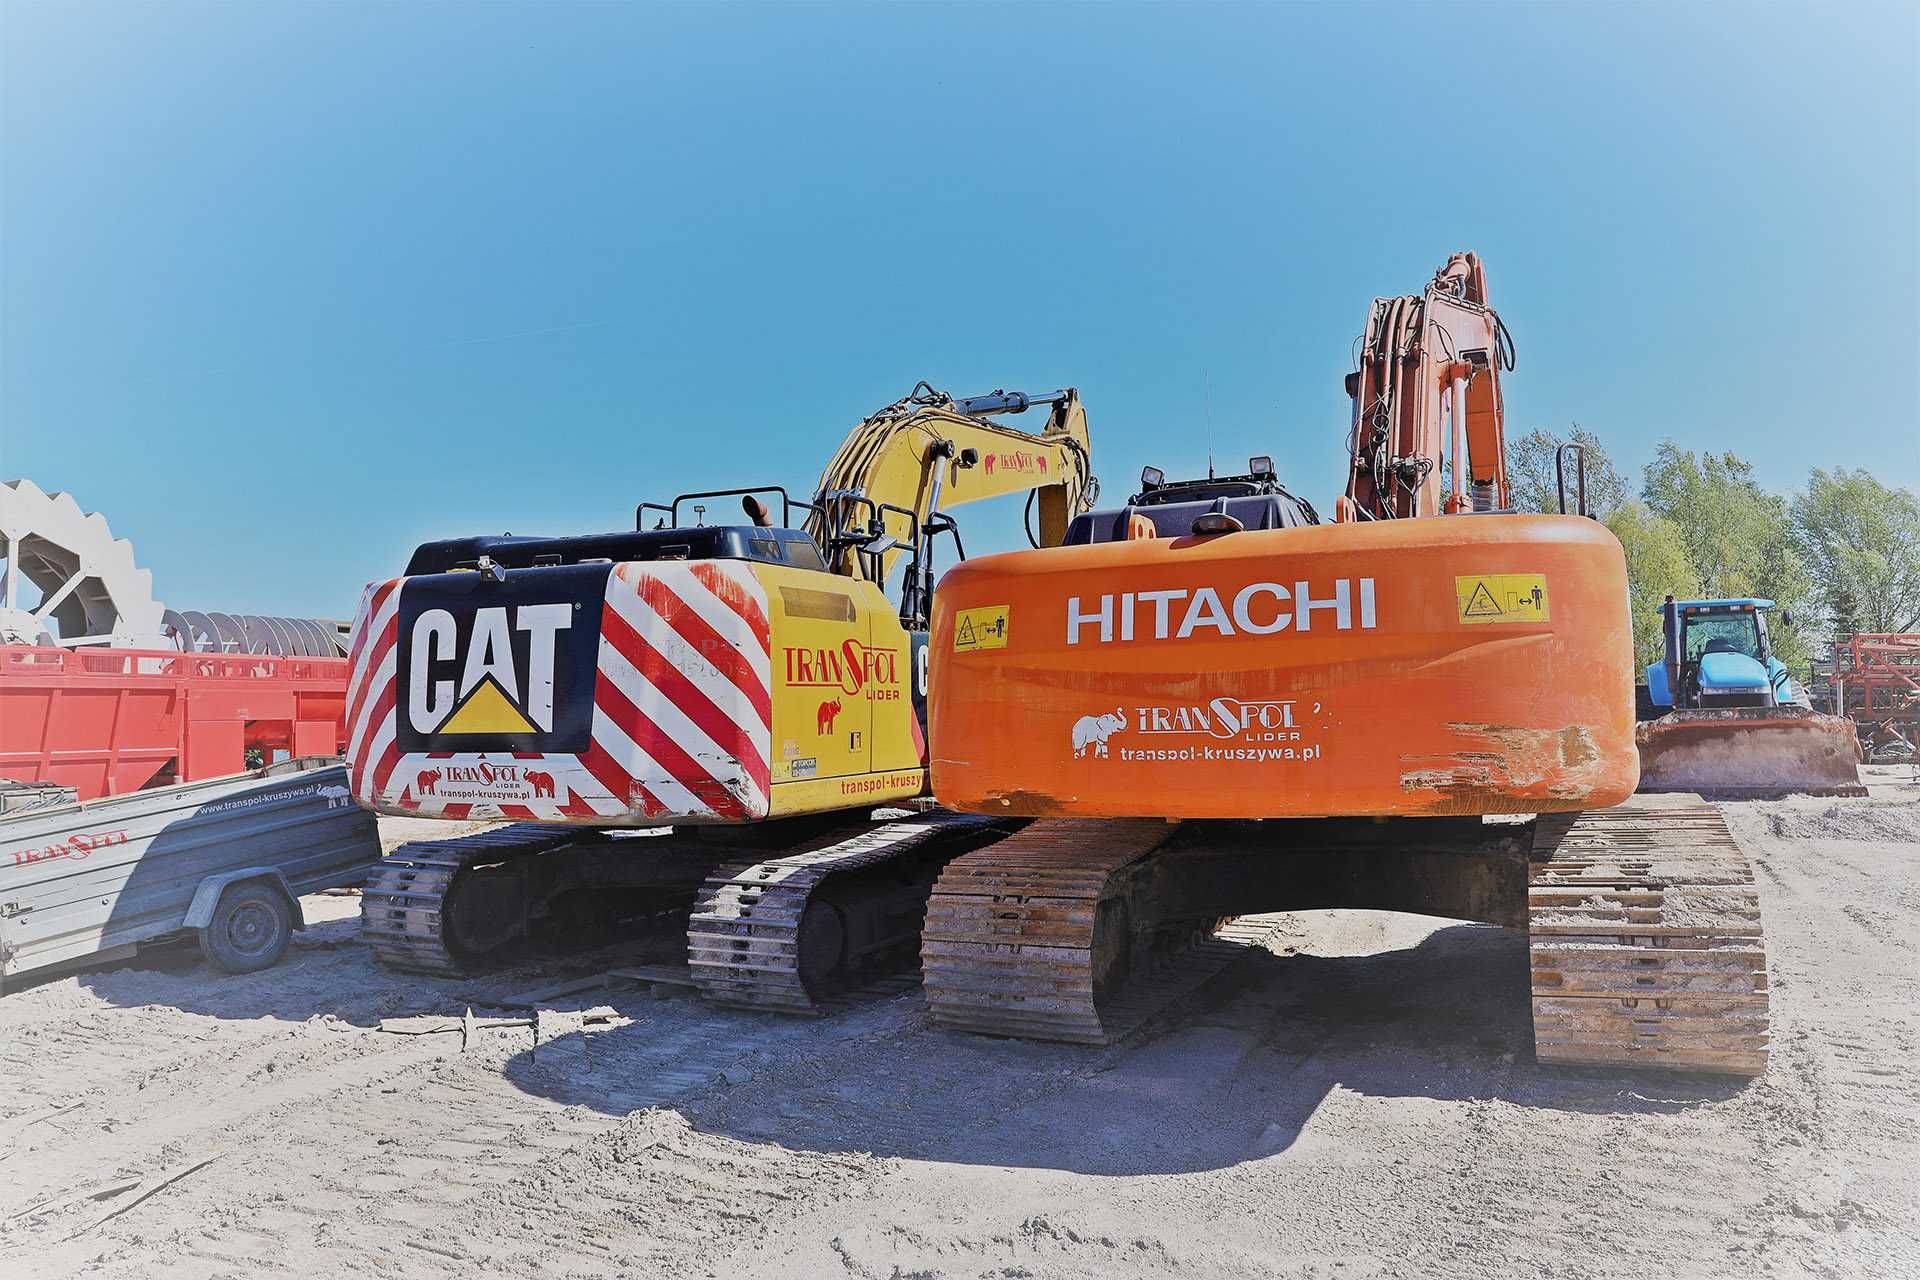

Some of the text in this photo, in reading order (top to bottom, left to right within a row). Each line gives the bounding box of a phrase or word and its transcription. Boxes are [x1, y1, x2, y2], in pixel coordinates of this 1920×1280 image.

[1067, 577, 1377, 645] HITACHI
[408, 603, 572, 734] CAT
[866, 690, 900, 700] LIDER
[1246, 732, 1301, 741] LIDER
[1120, 745, 1321, 762] transpol-kruszywa.pl
[200, 785, 315, 815] www.transpol-kruszywa.pl
[440, 789, 530, 800] transpol-kruszywa.pl
